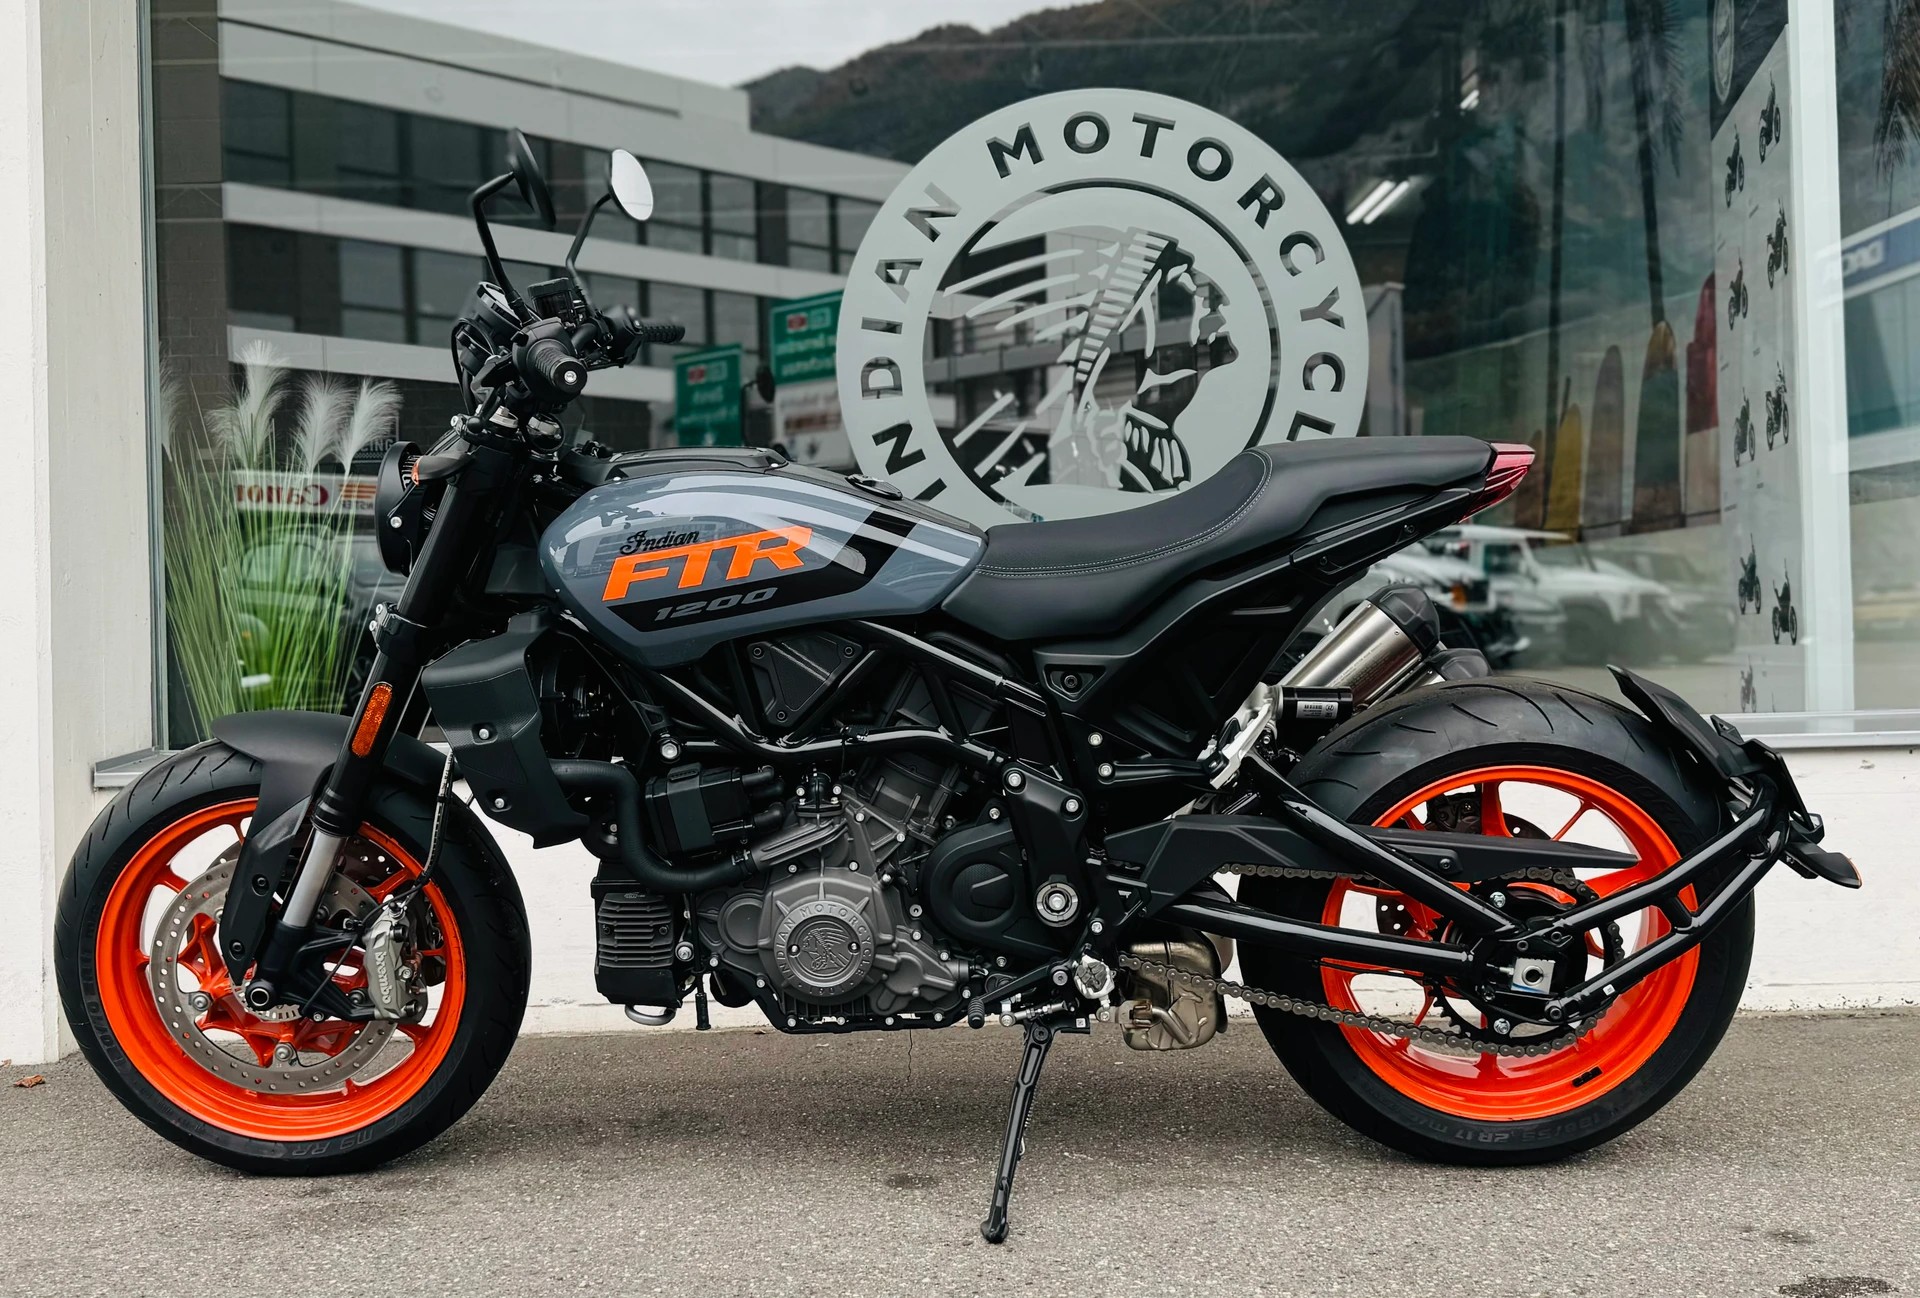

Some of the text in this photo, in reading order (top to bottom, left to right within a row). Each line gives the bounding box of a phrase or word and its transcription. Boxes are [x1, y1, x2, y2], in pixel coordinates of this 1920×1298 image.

[861, 111, 1347, 500] INDIAN MOTORCYCL
[602, 525, 813, 601] FTR
[620, 530, 700, 555] Indian
[654, 587, 778, 622] 1200
[776, 903, 872, 980] INDIAN MOTORCYCLE
[374, 951, 393, 1004] brembo
